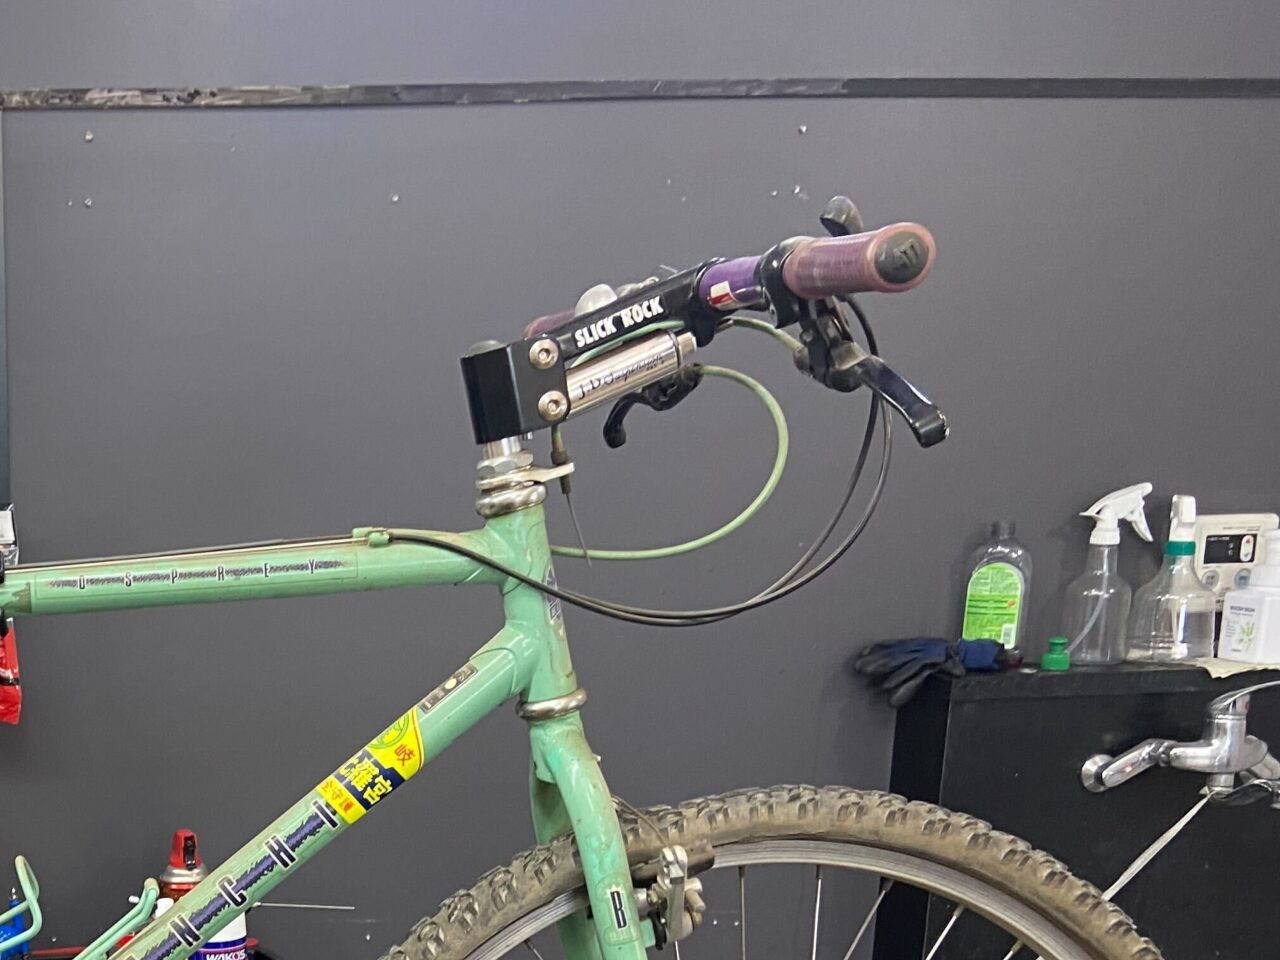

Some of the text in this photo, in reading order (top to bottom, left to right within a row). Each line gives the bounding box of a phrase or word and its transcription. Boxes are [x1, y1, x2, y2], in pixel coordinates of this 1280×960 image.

[574, 296, 664, 348] SLICK ROCK
[610, 890, 627, 929] B
